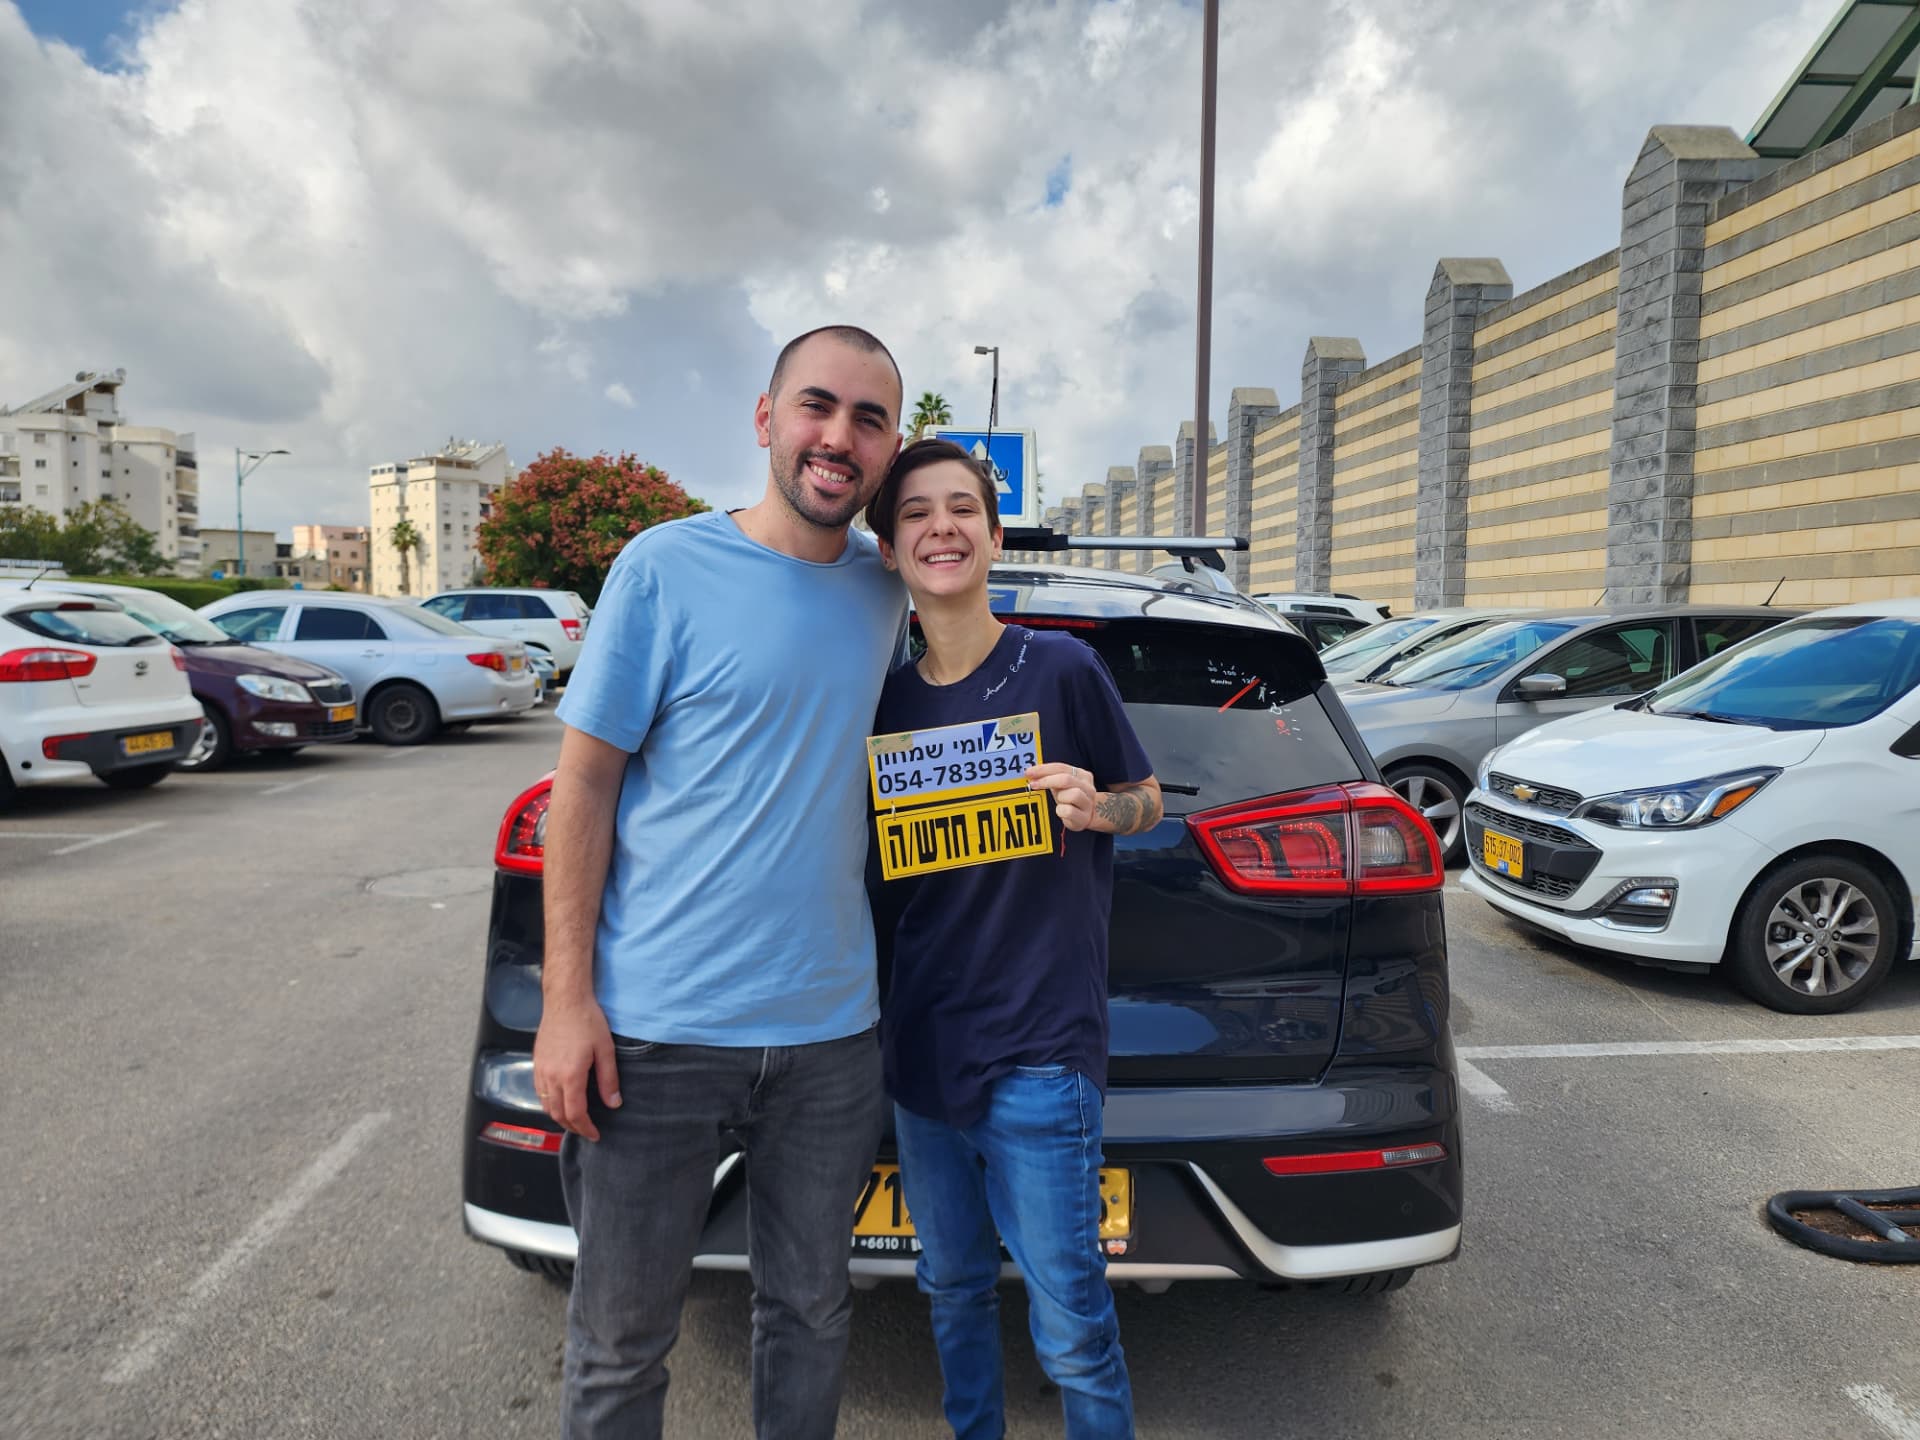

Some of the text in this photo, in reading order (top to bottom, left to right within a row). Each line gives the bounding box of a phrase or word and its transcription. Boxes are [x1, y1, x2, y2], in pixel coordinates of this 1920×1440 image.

[878, 752, 1036, 794] 054-7839343
[887, 802, 1043, 869] נהג/ת חדש/ה
